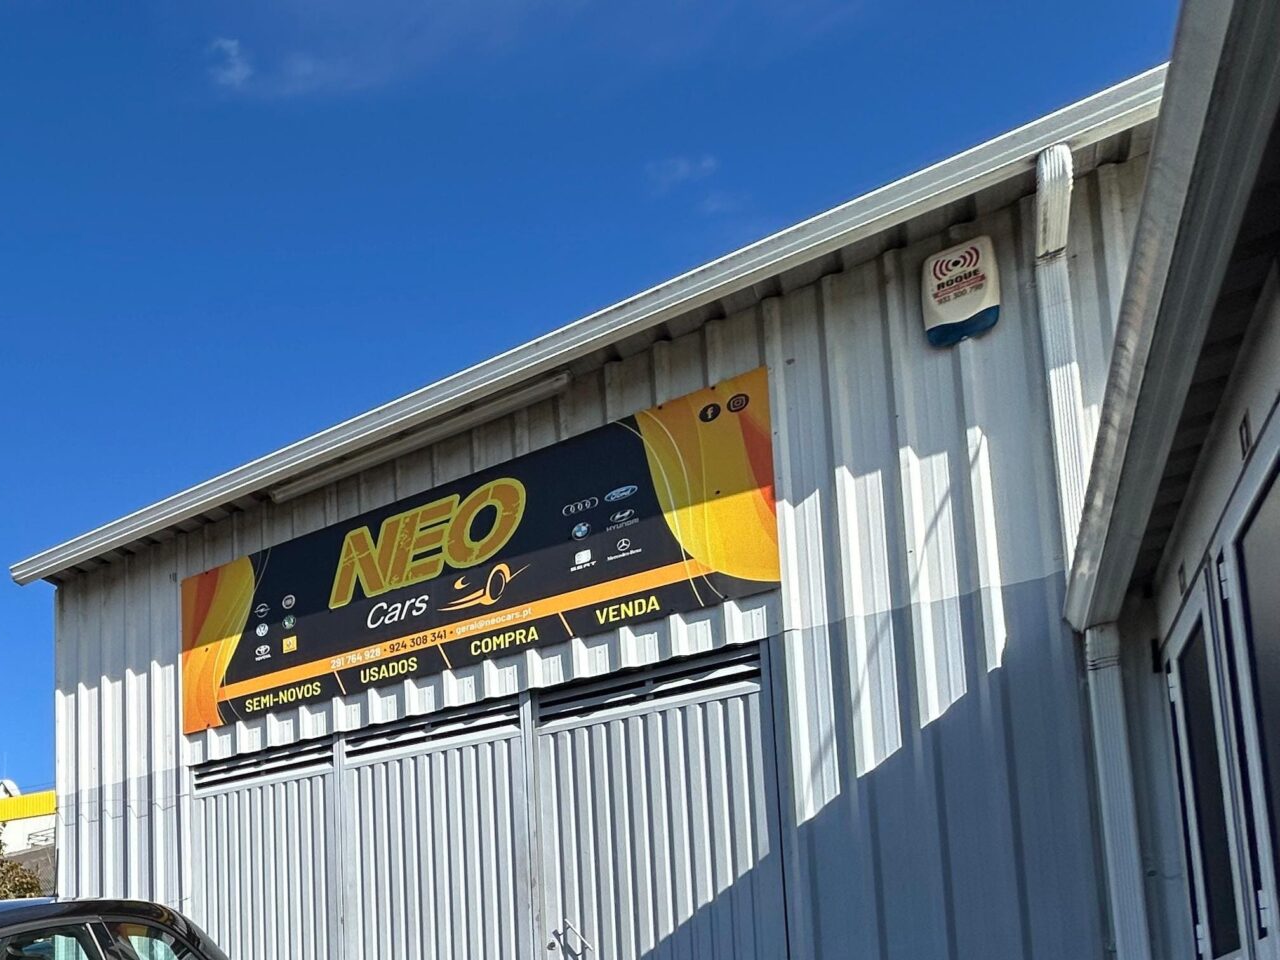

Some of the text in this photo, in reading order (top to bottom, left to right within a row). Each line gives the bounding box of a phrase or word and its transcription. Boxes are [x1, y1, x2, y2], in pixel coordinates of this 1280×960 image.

[936, 268, 980, 291] ROQUE
[328, 477, 527, 610] NEO
[366, 595, 430, 629] Cars
[389, 640, 407, 653] 924
[410, 635, 427, 648] 308
[430, 629, 447, 642] 341
[455, 608, 532, 634] geral@neocars.pt
[245, 595, 661, 713] SEMI-NOVOS USADOS COMPRA VENDA
